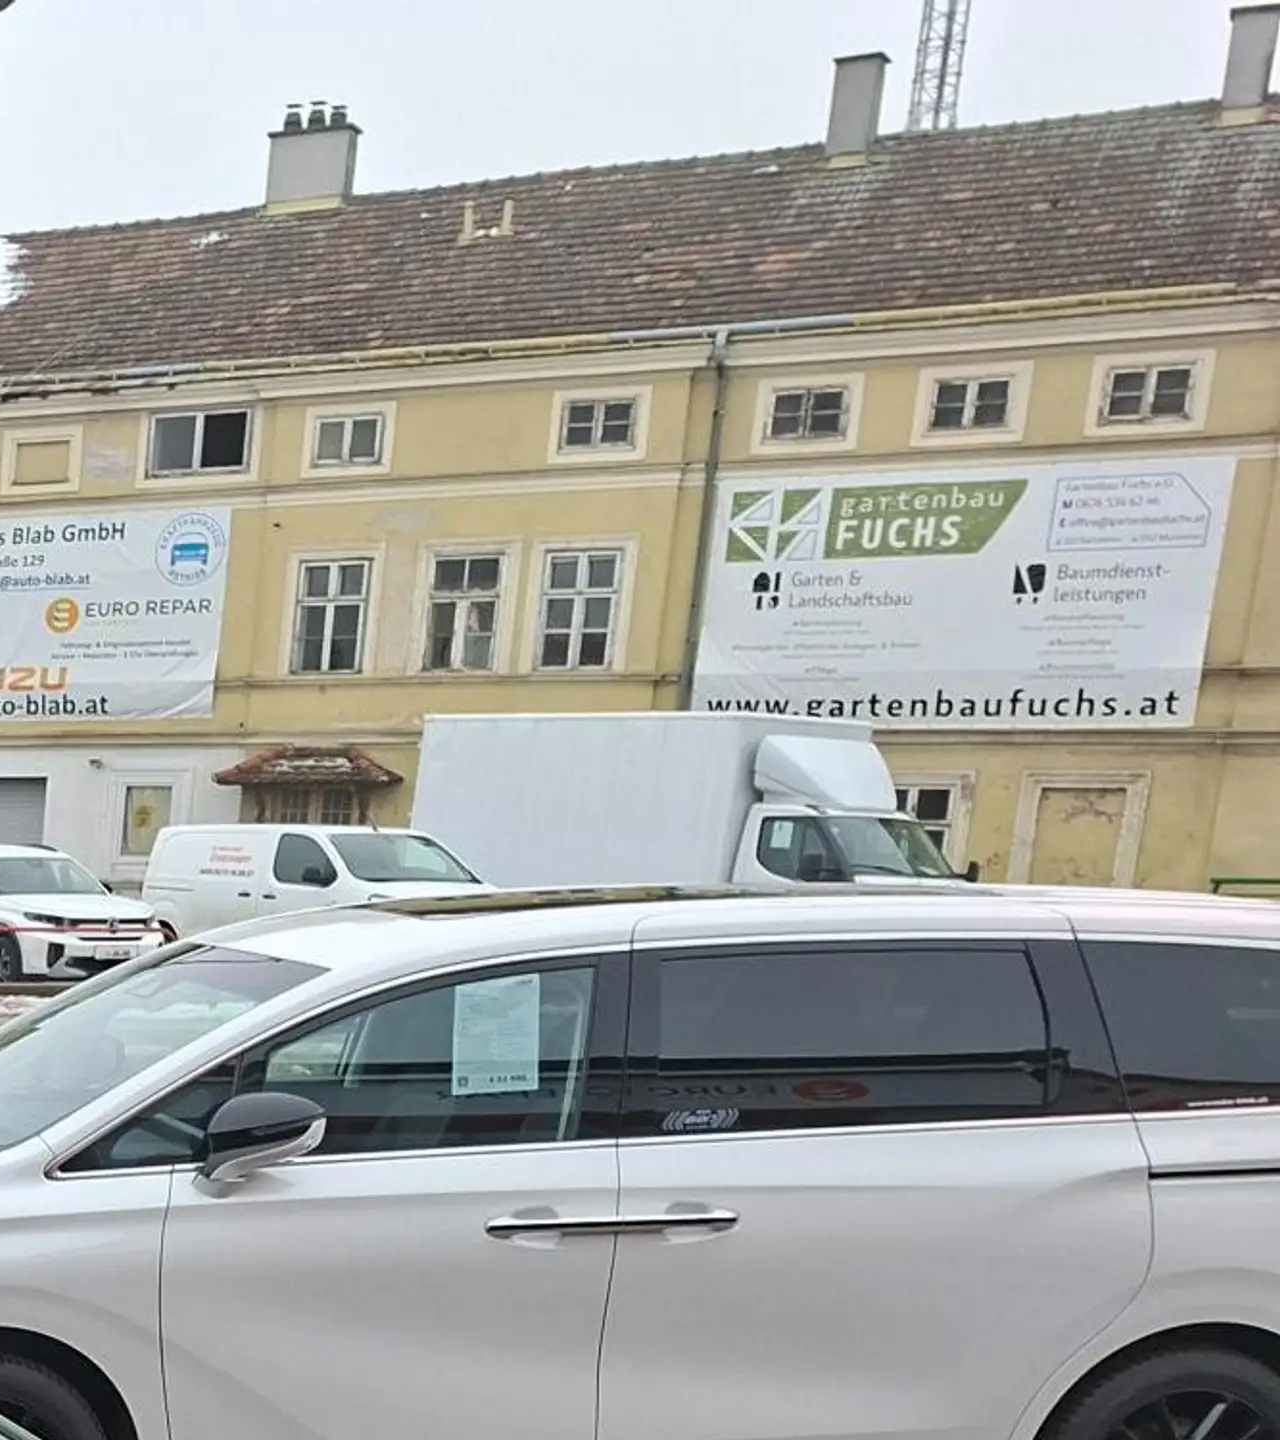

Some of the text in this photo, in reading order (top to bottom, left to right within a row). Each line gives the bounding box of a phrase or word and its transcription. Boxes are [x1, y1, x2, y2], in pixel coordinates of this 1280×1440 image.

[840, 485, 1005, 517] gartenbau
[12, 525, 55, 545] Blab
[61, 522, 126, 543] GmbH
[836, 515, 963, 550] FUCHS
[22, 553, 46, 568] 129
[791, 569, 862, 588] Garten &
[1056, 562, 1171, 581] Baumdienst-
[788, 589, 914, 609] Landschaftsbau
[1052, 586, 1147, 604] leistungen
[85, 598, 213, 618] EURO REPAR
[707, 688, 1180, 719] www.gartenbaufuchs.at
